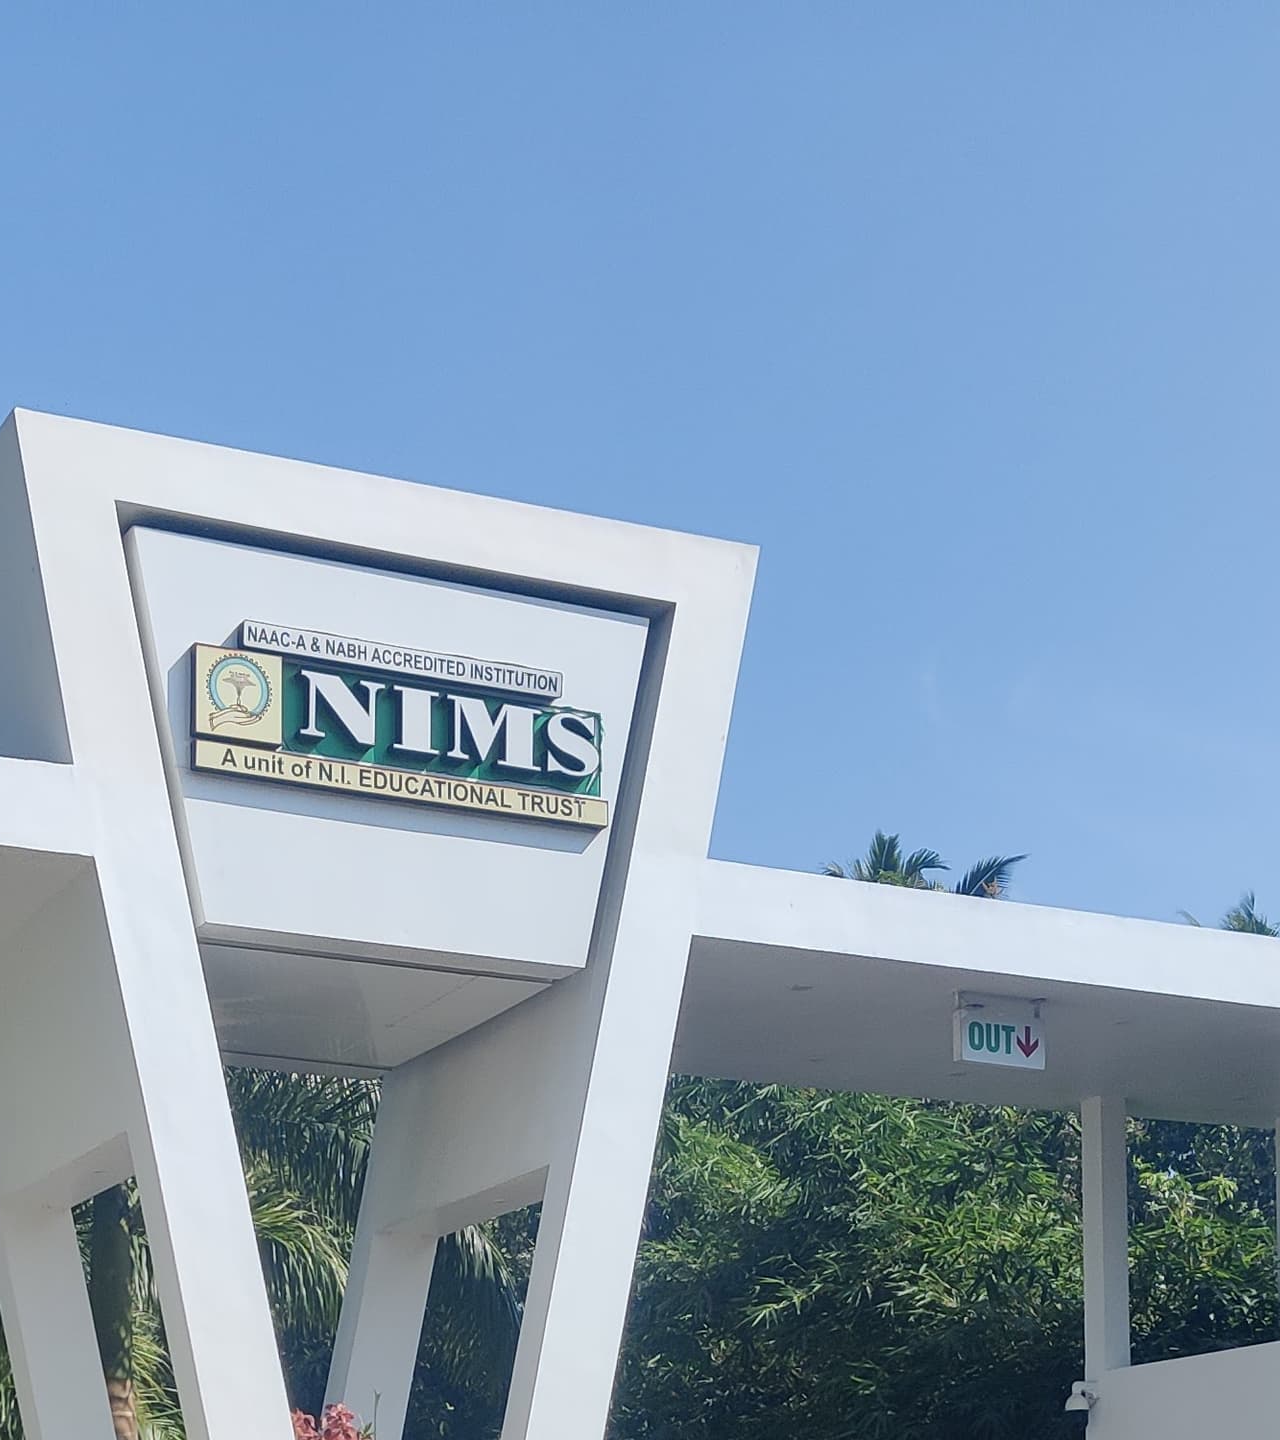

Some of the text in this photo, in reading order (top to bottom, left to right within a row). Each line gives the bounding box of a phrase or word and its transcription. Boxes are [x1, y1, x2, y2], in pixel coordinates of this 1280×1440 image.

[247, 626, 558, 693] NAAC-A & NABH ACCREDITED INSTITUTION
[300, 669, 601, 779] NIMS
[221, 748, 586, 819] A unit of N.I. EDUCATIONAL TRUST
[968, 1021, 1016, 1055] OUT
